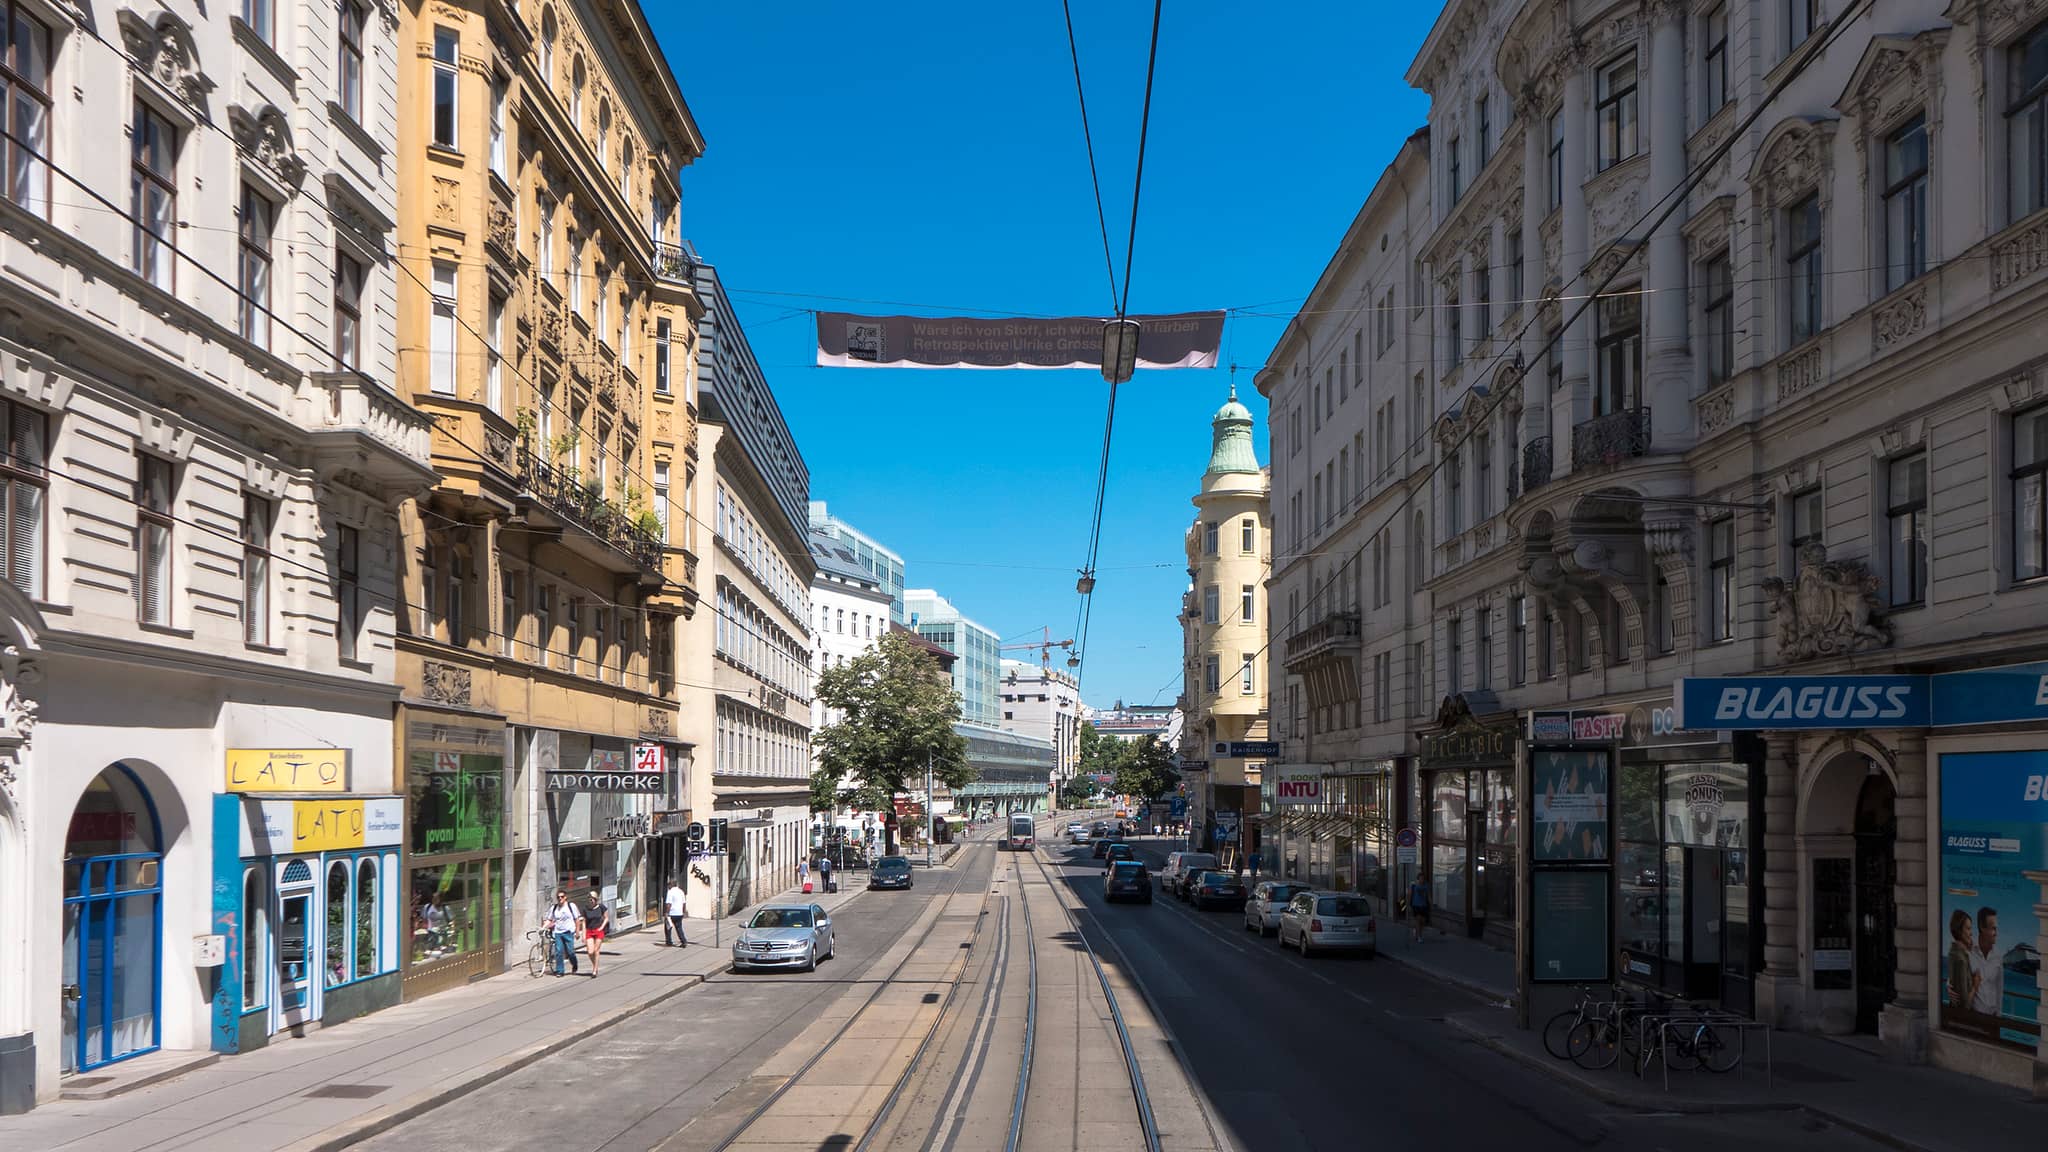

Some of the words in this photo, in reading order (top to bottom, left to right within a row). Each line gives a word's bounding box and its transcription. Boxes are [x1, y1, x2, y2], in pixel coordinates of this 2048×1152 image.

[952, 322, 972, 336] ich
[976, 326, 1000, 336] von
[1046, 324, 1066, 335] ich
[1070, 323, 1104, 335] würd
[914, 338, 1009, 352] Retrospektive
[1013, 337, 1053, 351] Ulrike
[1714, 687, 1912, 720] BLAGUSS
[1573, 713, 1627, 740] TASTY
[232, 761, 337, 785] LATO
[1689, 773, 1721, 786] TASTY
[548, 774, 660, 790] APOTHEKE
[1278, 782, 1320, 797] INTU
[1685, 786, 1724, 806] DONUTS
[297, 808, 361, 840] LATO
[1946, 836, 1987, 848] BLAGUSS
